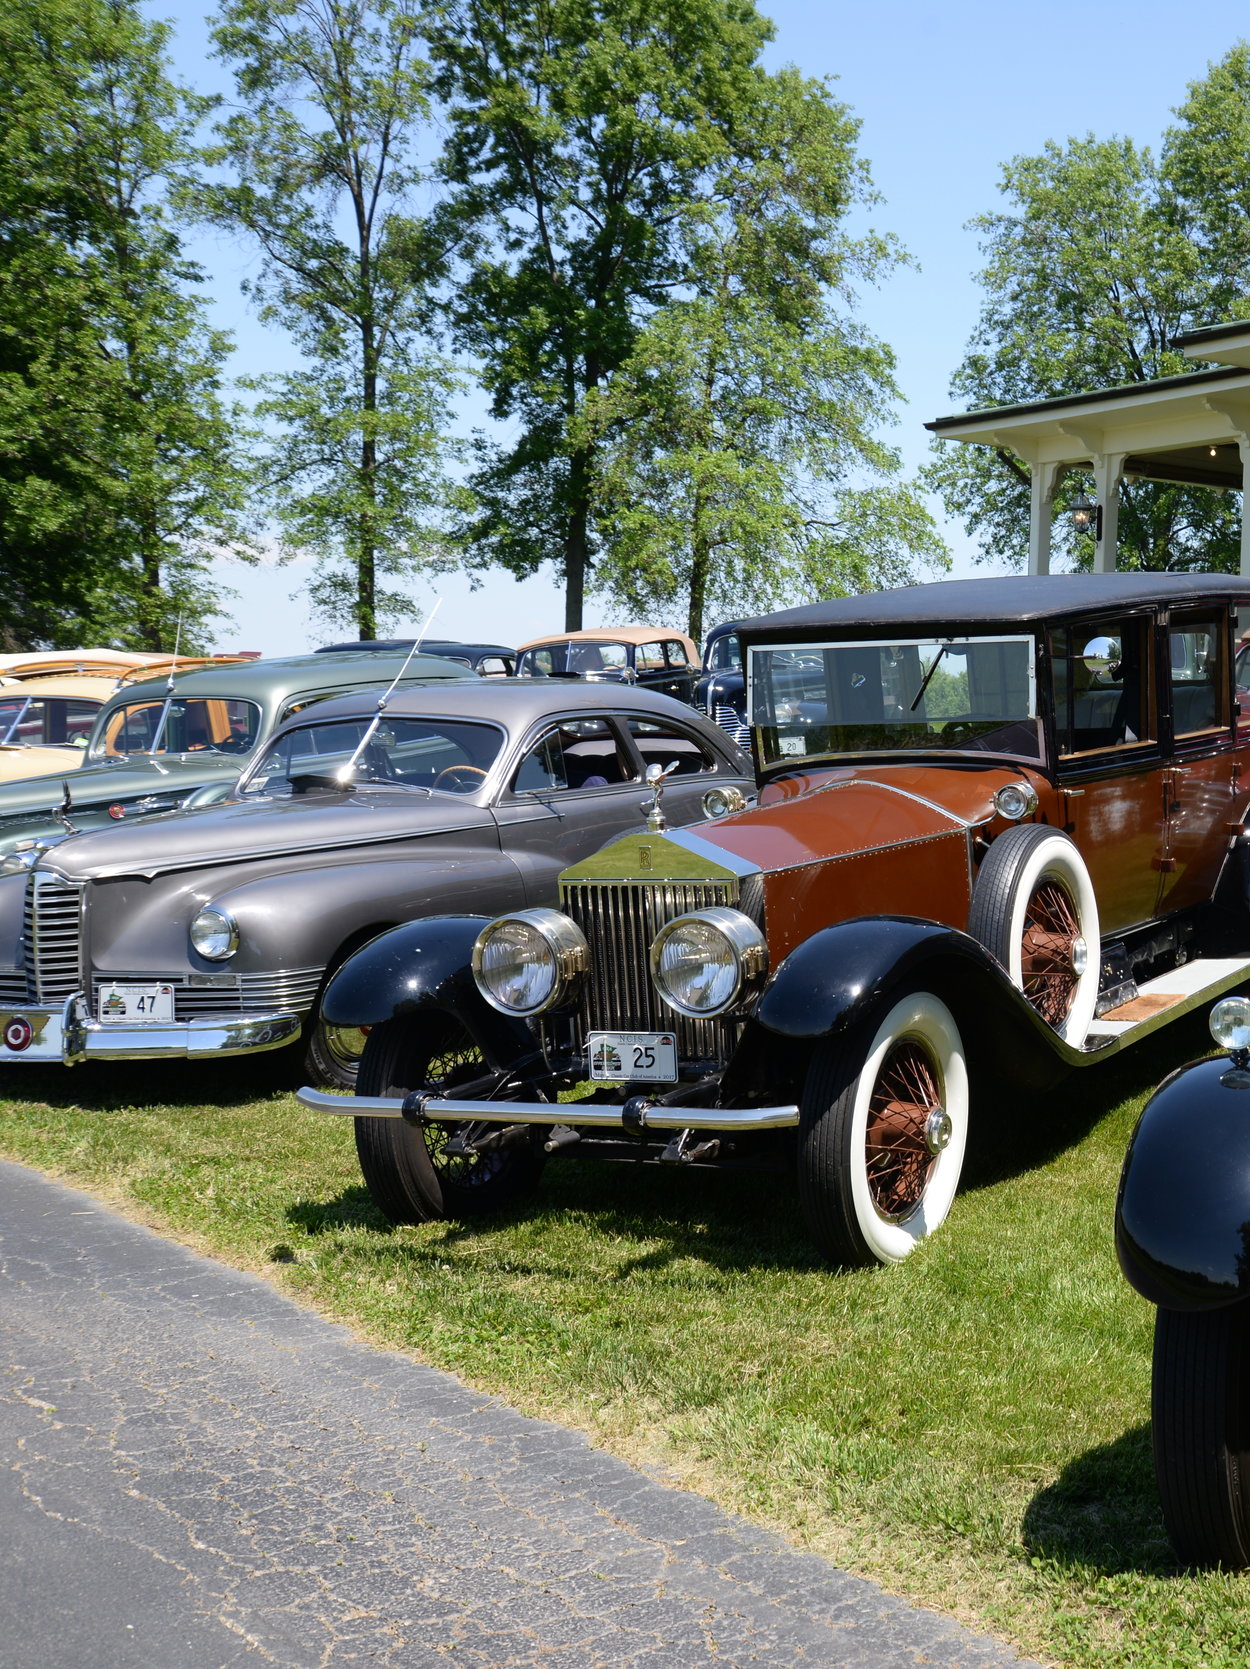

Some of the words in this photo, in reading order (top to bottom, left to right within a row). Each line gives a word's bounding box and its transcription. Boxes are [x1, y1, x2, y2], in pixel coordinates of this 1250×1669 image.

[137, 996, 156, 1014] 47
[619, 1035, 644, 1043] NCIS
[633, 1046, 656, 1069] 25
